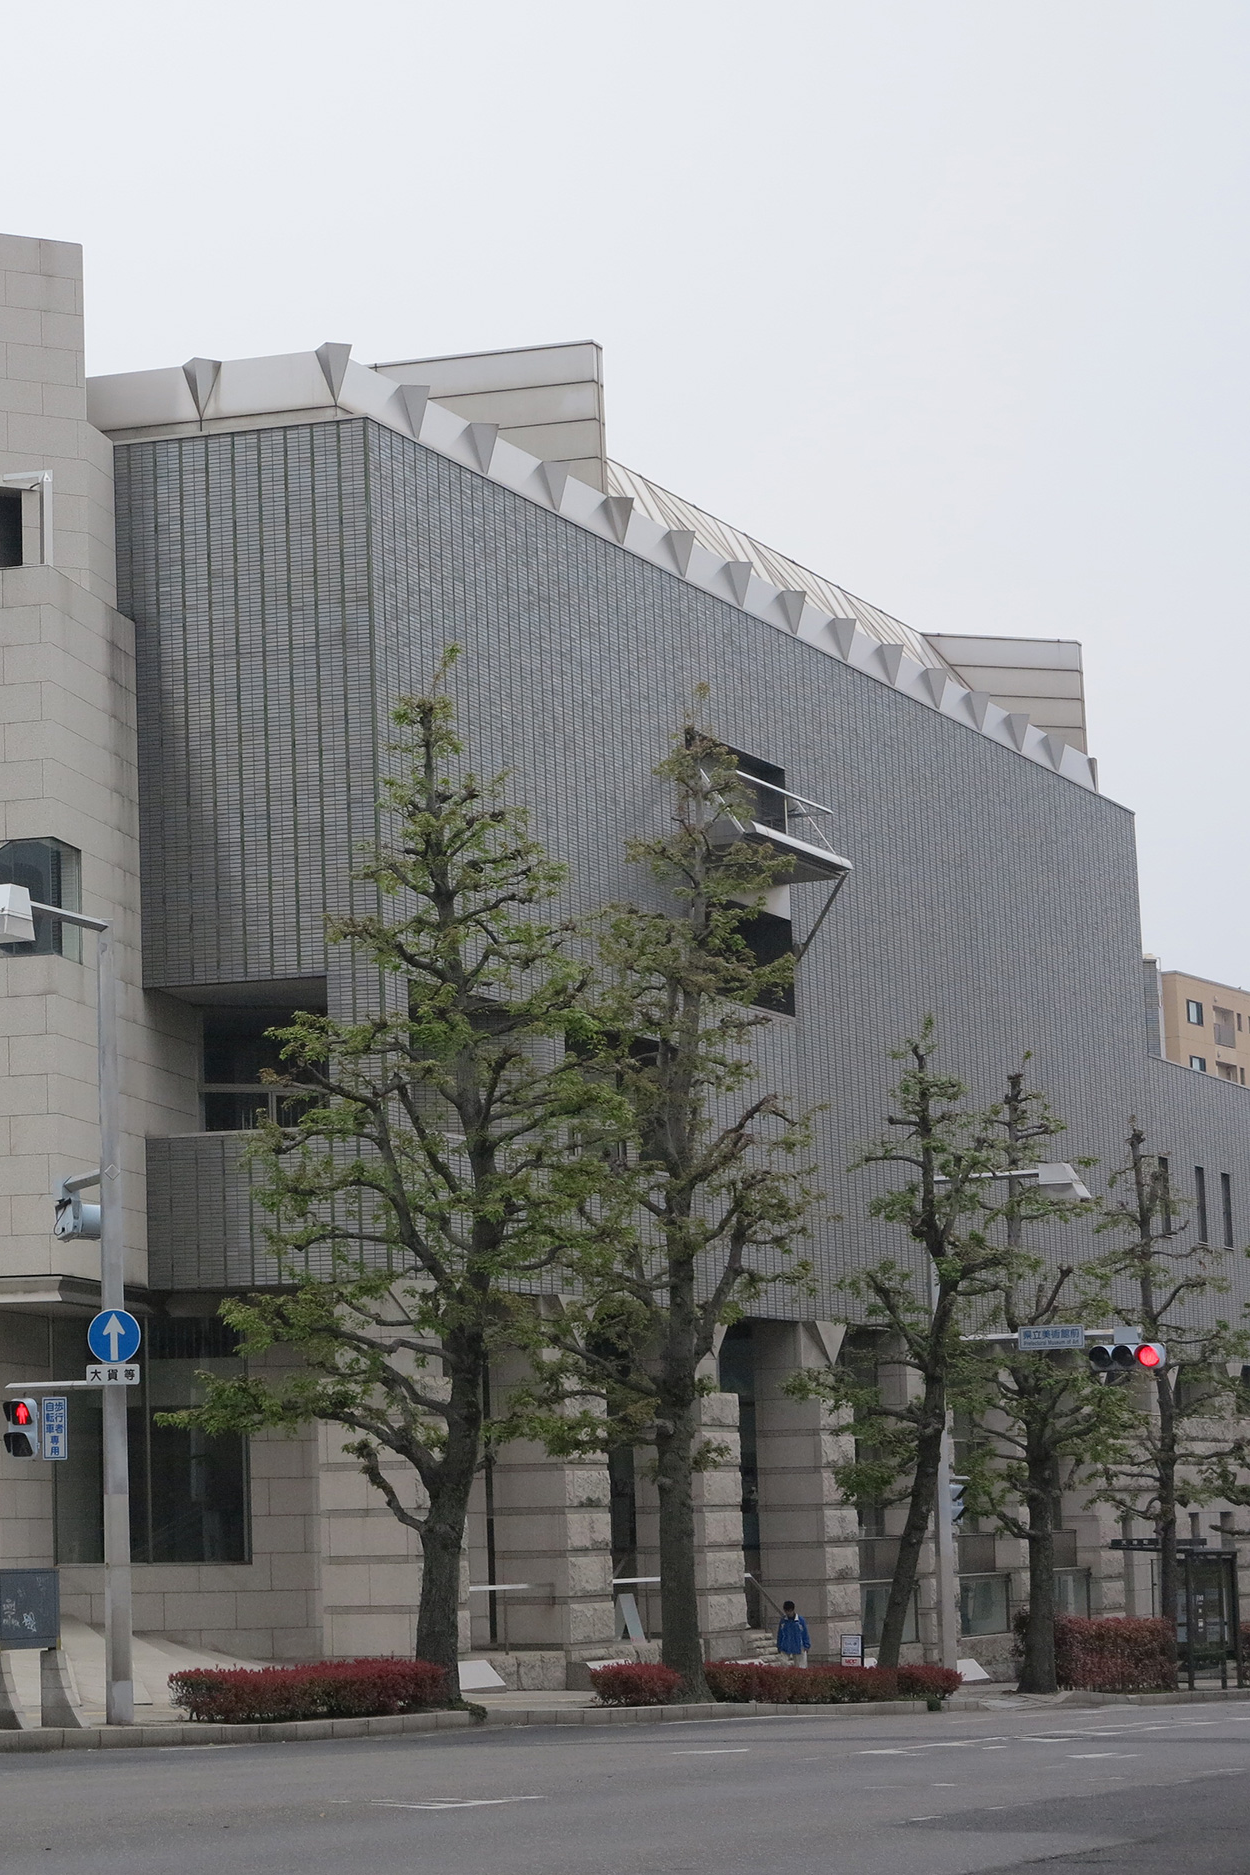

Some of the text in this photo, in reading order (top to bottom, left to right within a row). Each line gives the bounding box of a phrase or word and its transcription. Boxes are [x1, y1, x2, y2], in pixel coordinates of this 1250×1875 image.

[1023, 1328, 1080, 1340] 県立美術館前
[90, 1369, 135, 1381] 大貨等
[45, 1402, 54, 1433] 自転車
[54, 1402, 64, 1433] 歩行者
[50, 1435, 60, 1456] 専用
